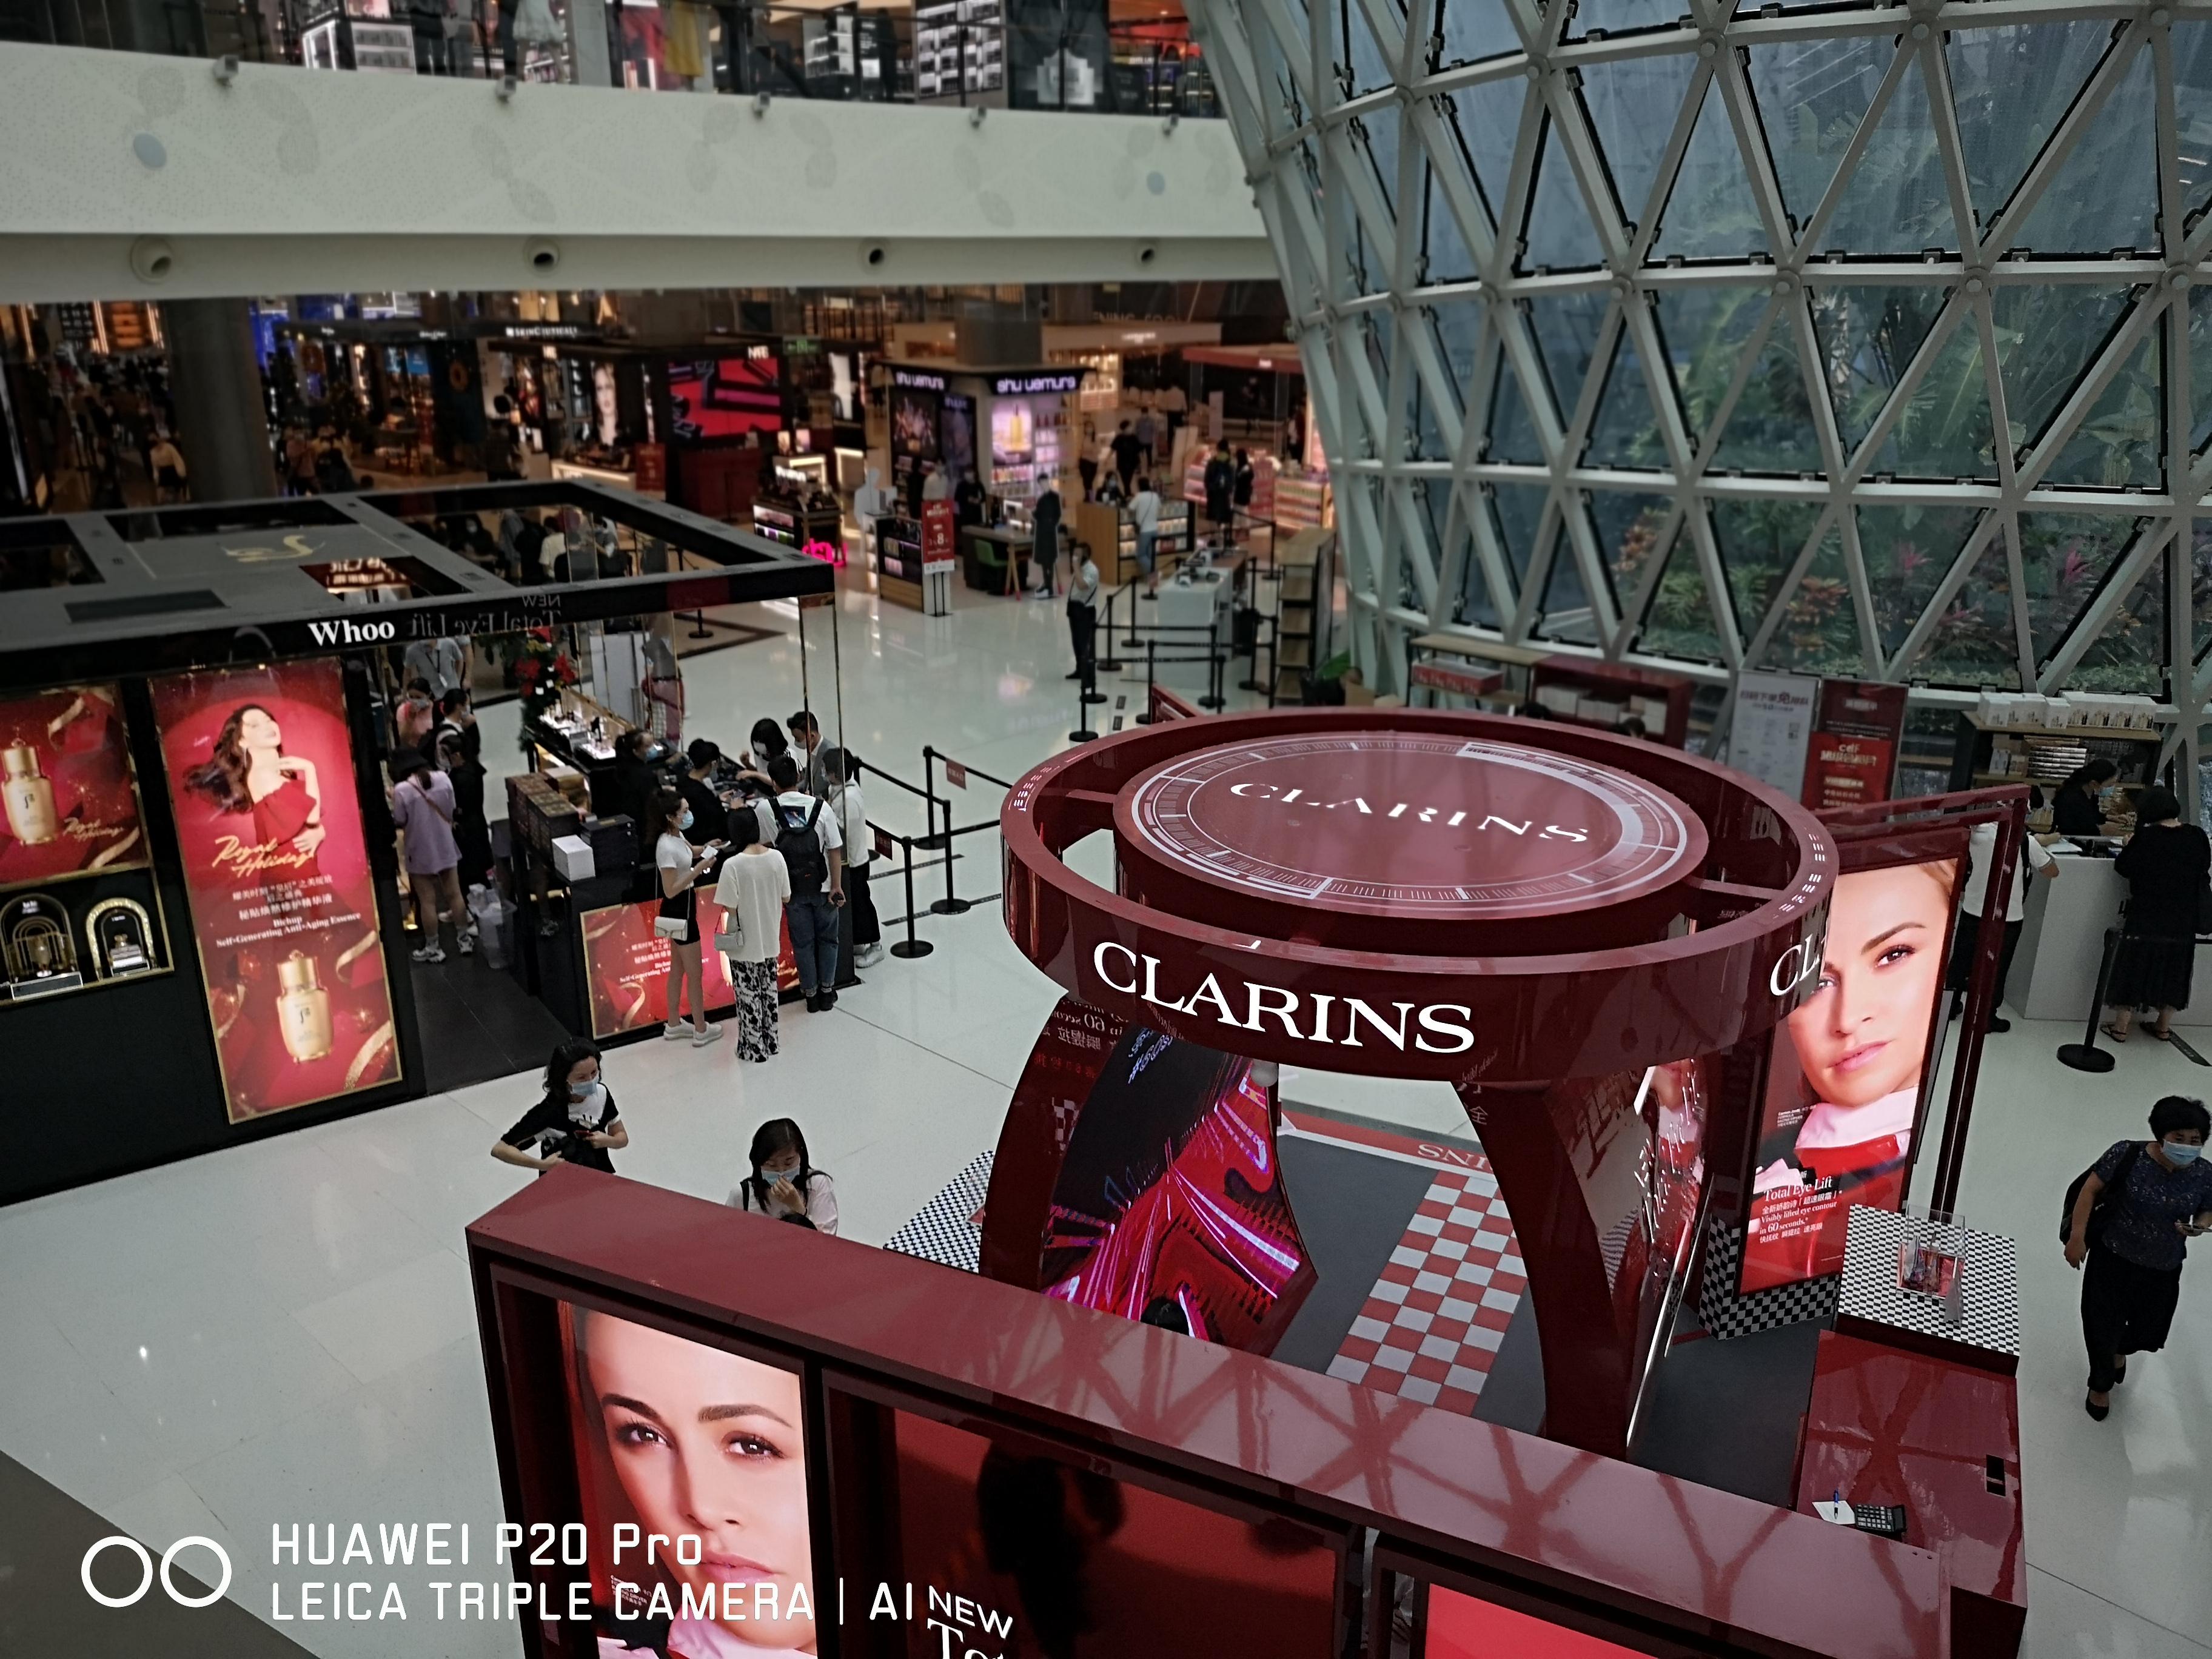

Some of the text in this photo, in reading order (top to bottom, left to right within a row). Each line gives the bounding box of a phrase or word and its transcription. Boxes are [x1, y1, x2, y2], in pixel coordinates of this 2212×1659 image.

[997, 376, 1076, 393] shu uemura
[308, 620, 396, 647] Whoo
[1231, 783, 1589, 842] CLARINS
[212, 836, 278, 868] Royal
[231, 851, 314, 878] Holiday
[216, 927, 283, 948] Self-Generating
[330, 913, 362, 925] Essence
[1770, 933, 1820, 996] CL
[1094, 942, 1475, 1053] CLARINS
[1763, 1175, 1833, 1201] Total Eye Lift
[1760, 1201, 1837, 1224] Visibly lifted eye contour
[1759, 1226, 1767, 1235] in
[1768, 1222, 1779, 1233] 60
[929, 1585, 1013, 1639] NEW
